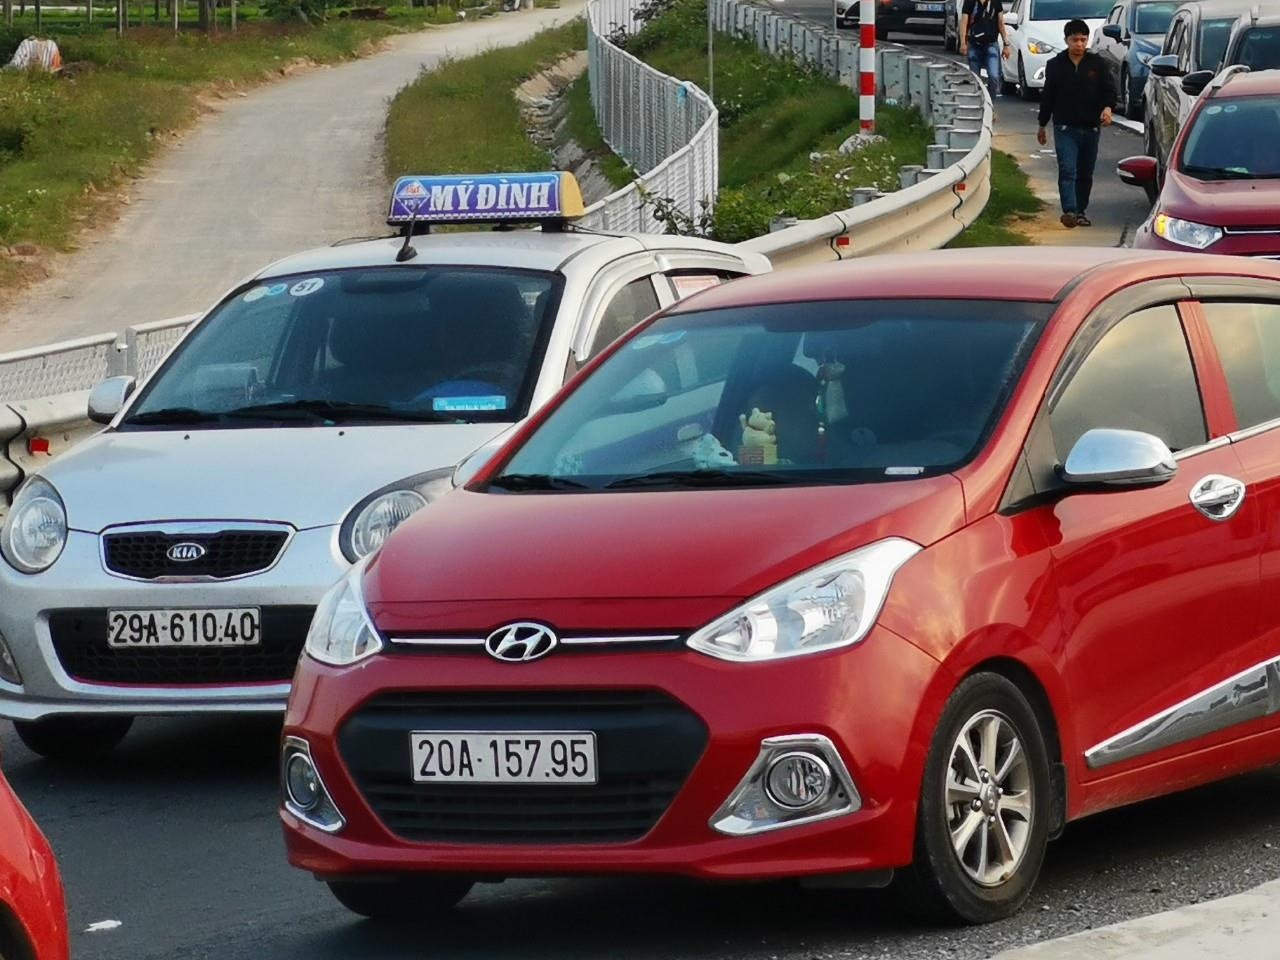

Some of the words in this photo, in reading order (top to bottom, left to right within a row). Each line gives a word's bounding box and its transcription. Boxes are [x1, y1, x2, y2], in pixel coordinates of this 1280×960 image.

[429, 180, 474, 212] MỸ
[475, 178, 551, 210] ĐÌNH
[172, 545, 198, 559] KIA
[112, 611, 256, 644] 29A-610.40
[418, 739, 589, 778] 20A-157.95
